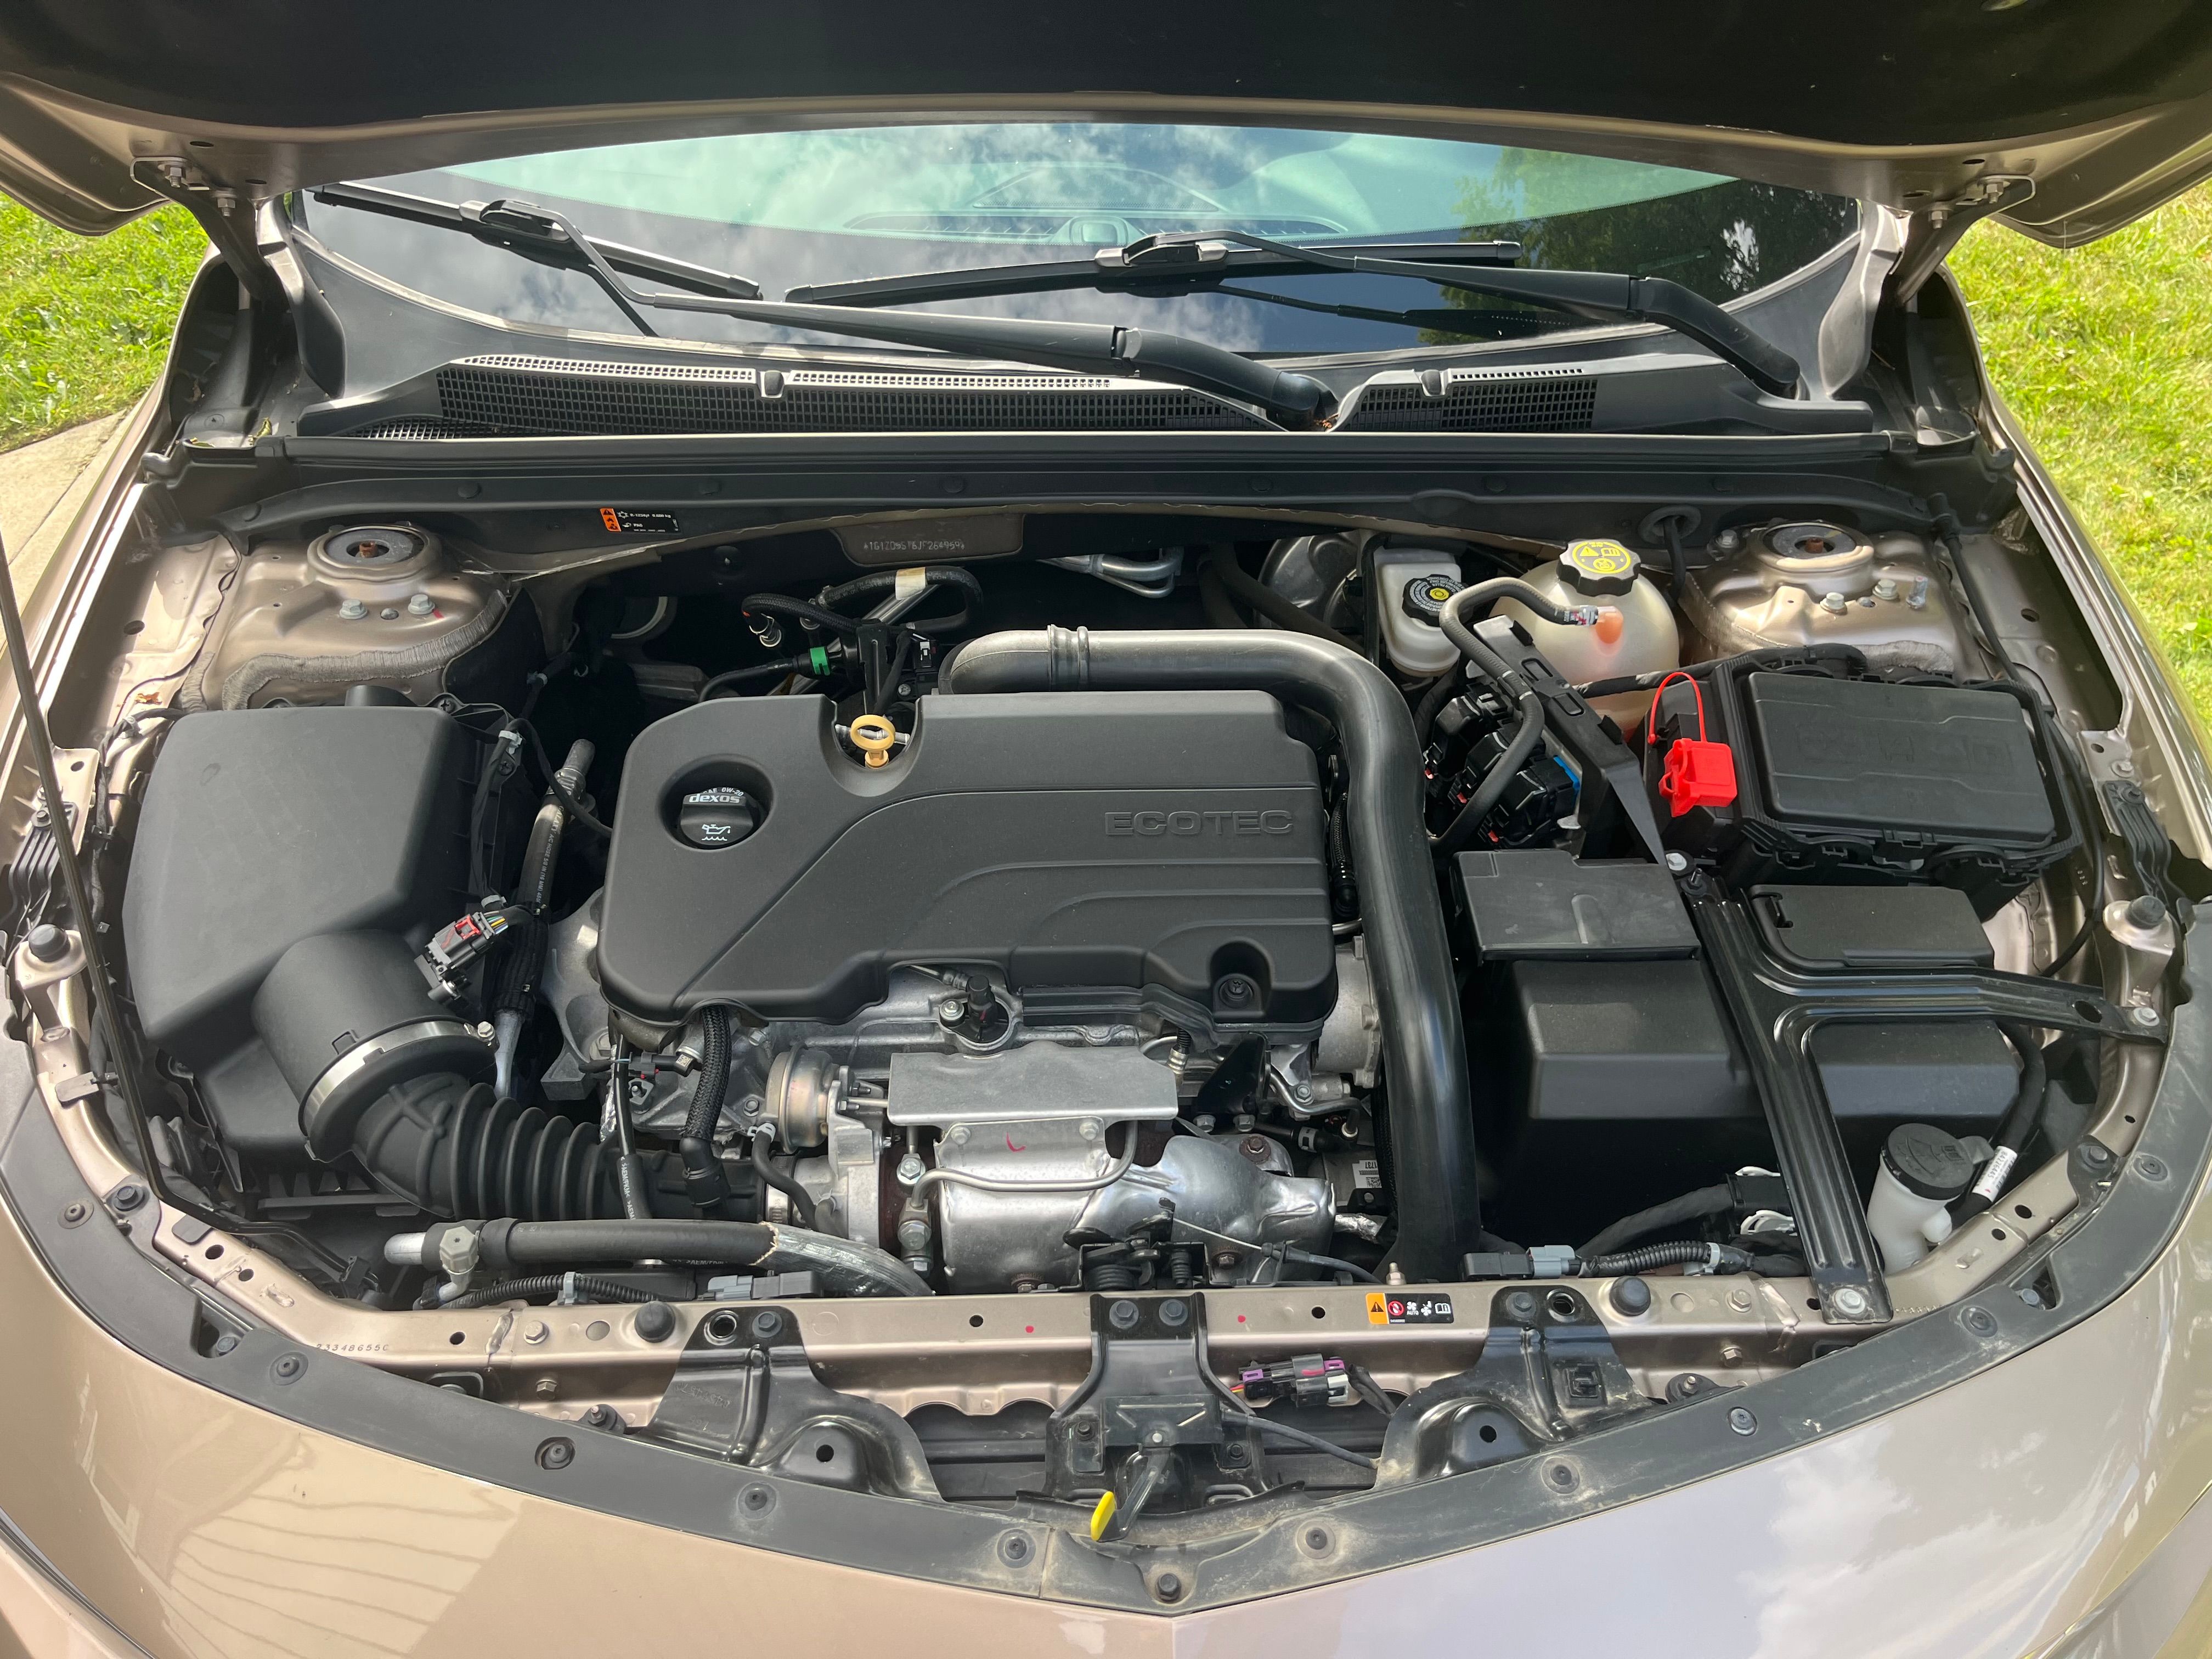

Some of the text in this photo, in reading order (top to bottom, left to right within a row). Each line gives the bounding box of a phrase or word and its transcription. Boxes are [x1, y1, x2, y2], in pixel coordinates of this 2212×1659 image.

[721, 787, 744, 796] 0W-20
[689, 794, 741, 804] dexos
[1105, 810, 1293, 835] ECOTEC
